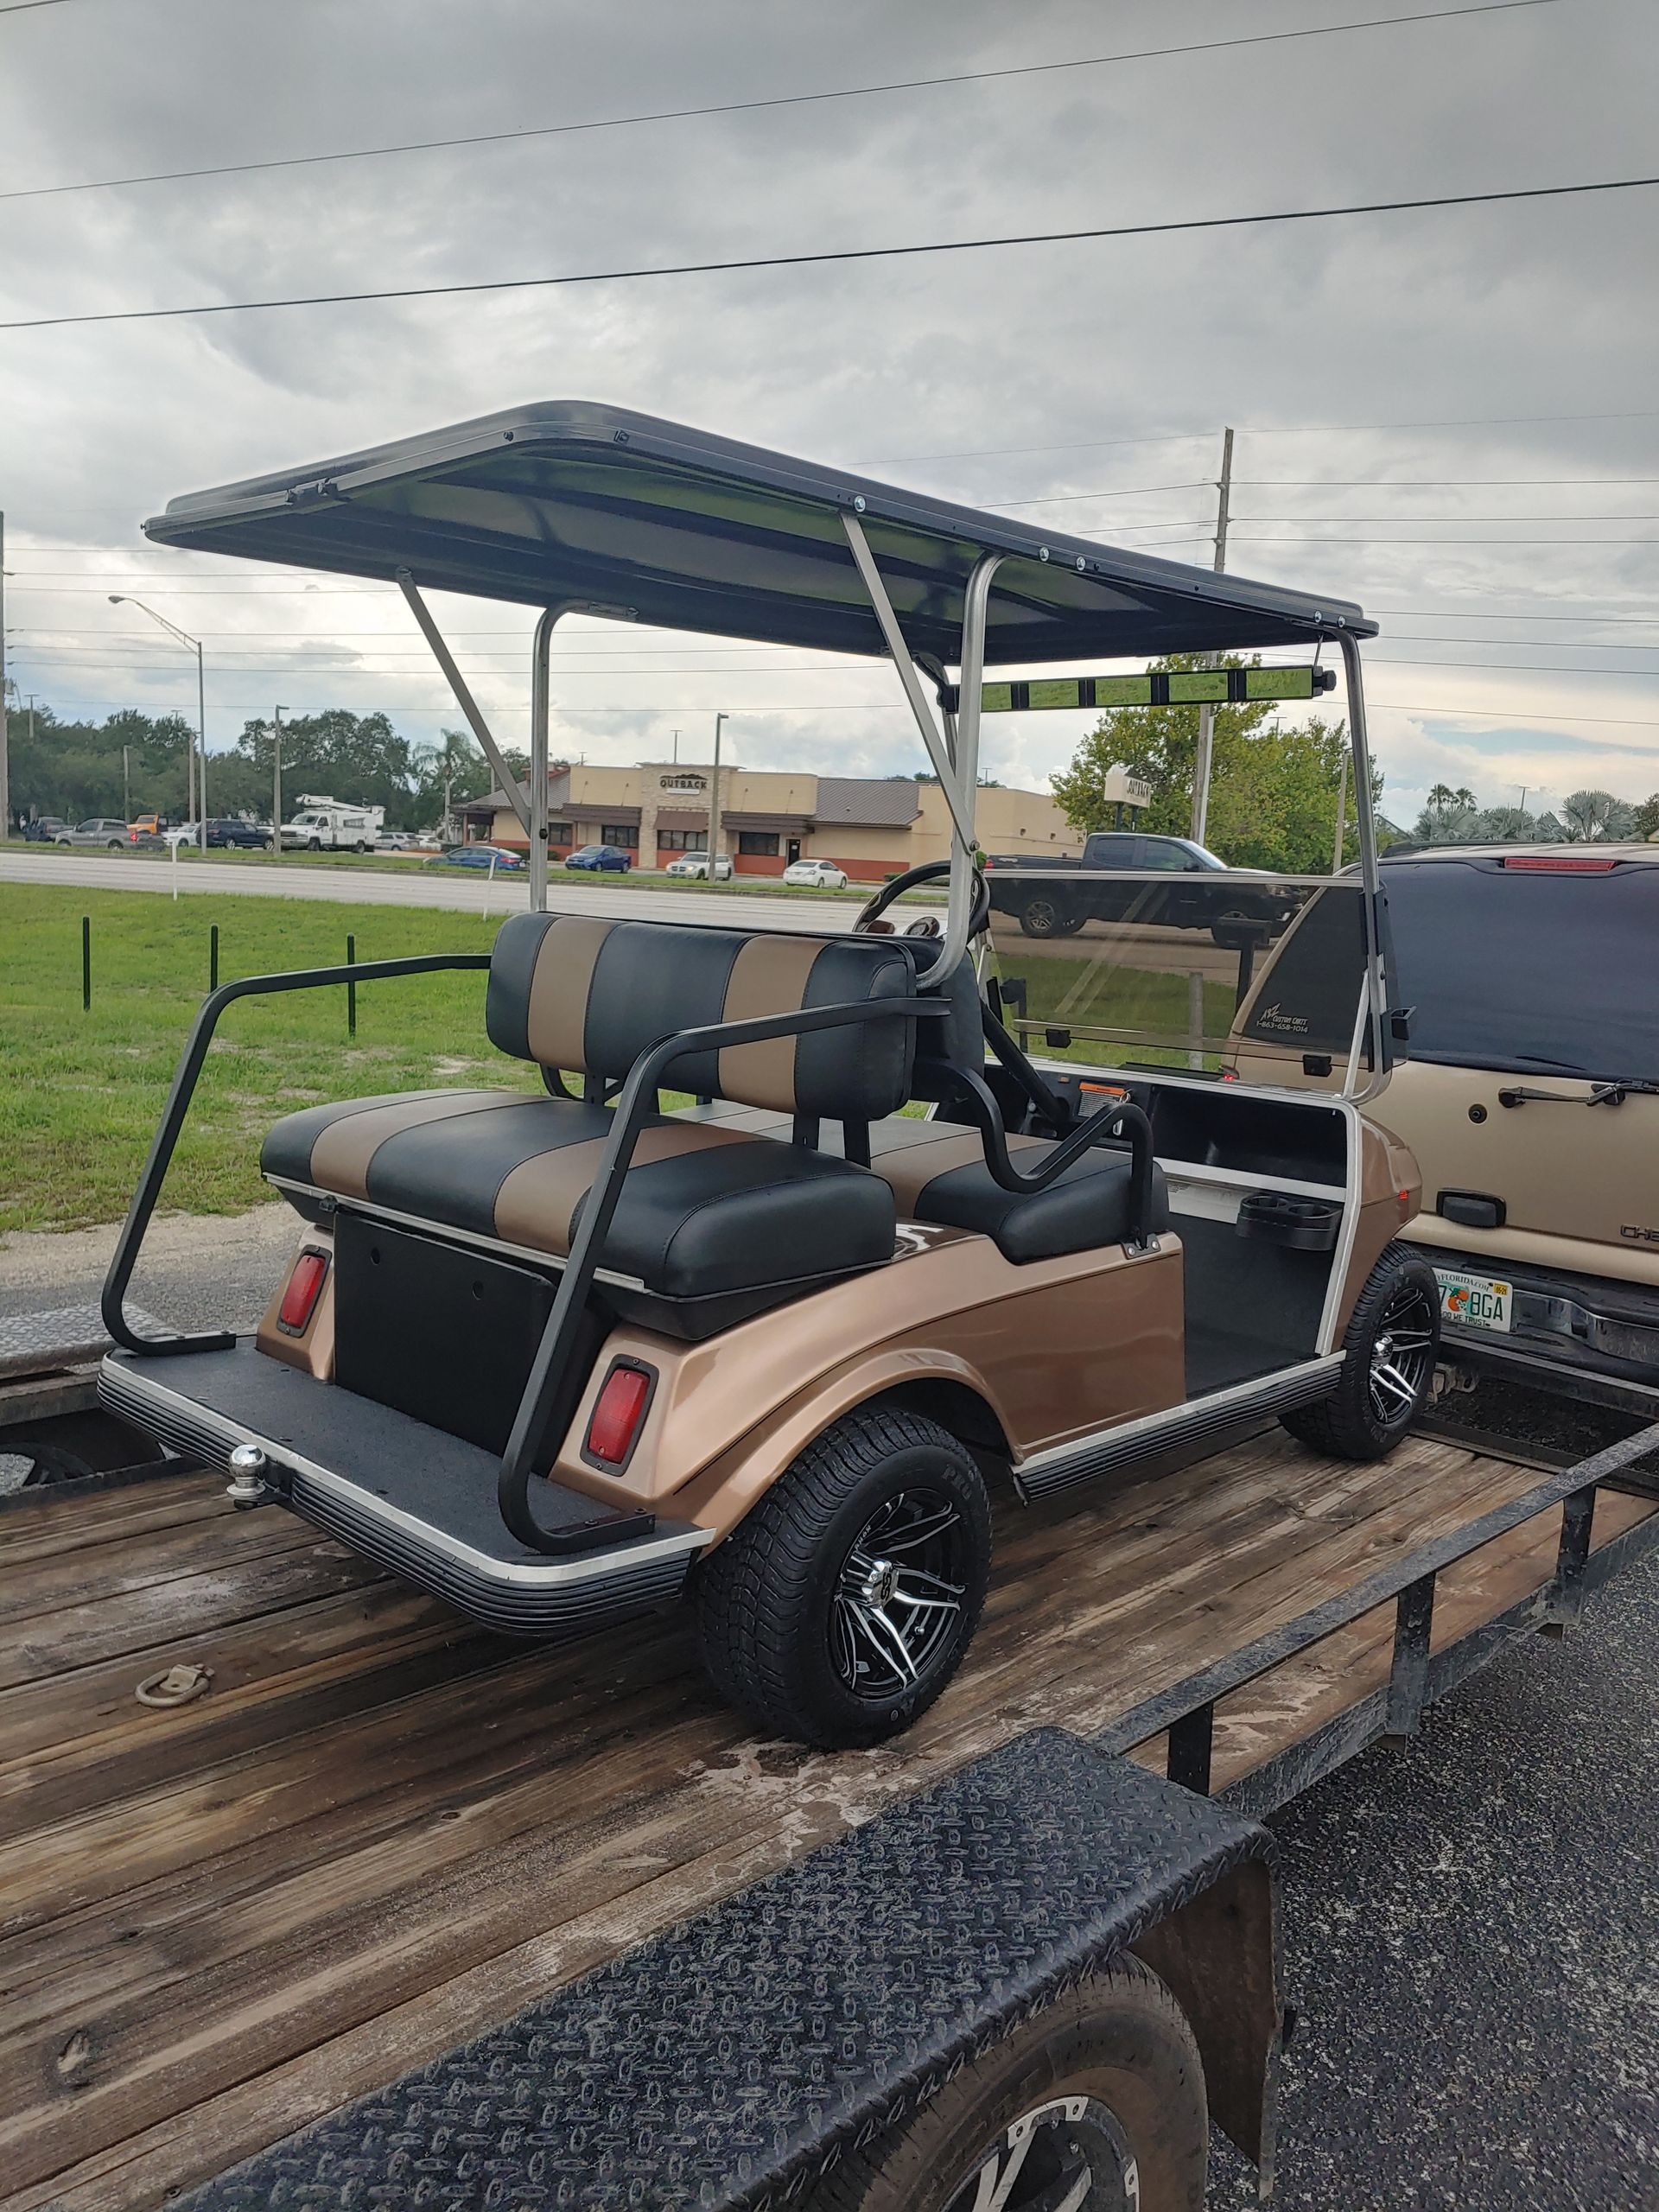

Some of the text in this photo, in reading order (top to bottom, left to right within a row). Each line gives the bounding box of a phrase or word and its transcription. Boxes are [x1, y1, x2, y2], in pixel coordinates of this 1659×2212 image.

[659, 779, 708, 789] OUTBACK
[1470, 1291, 1503, 1321] 8GA
[1453, 1313, 1463, 1322] WE
[1465, 1316, 1486, 1327] TRUST
